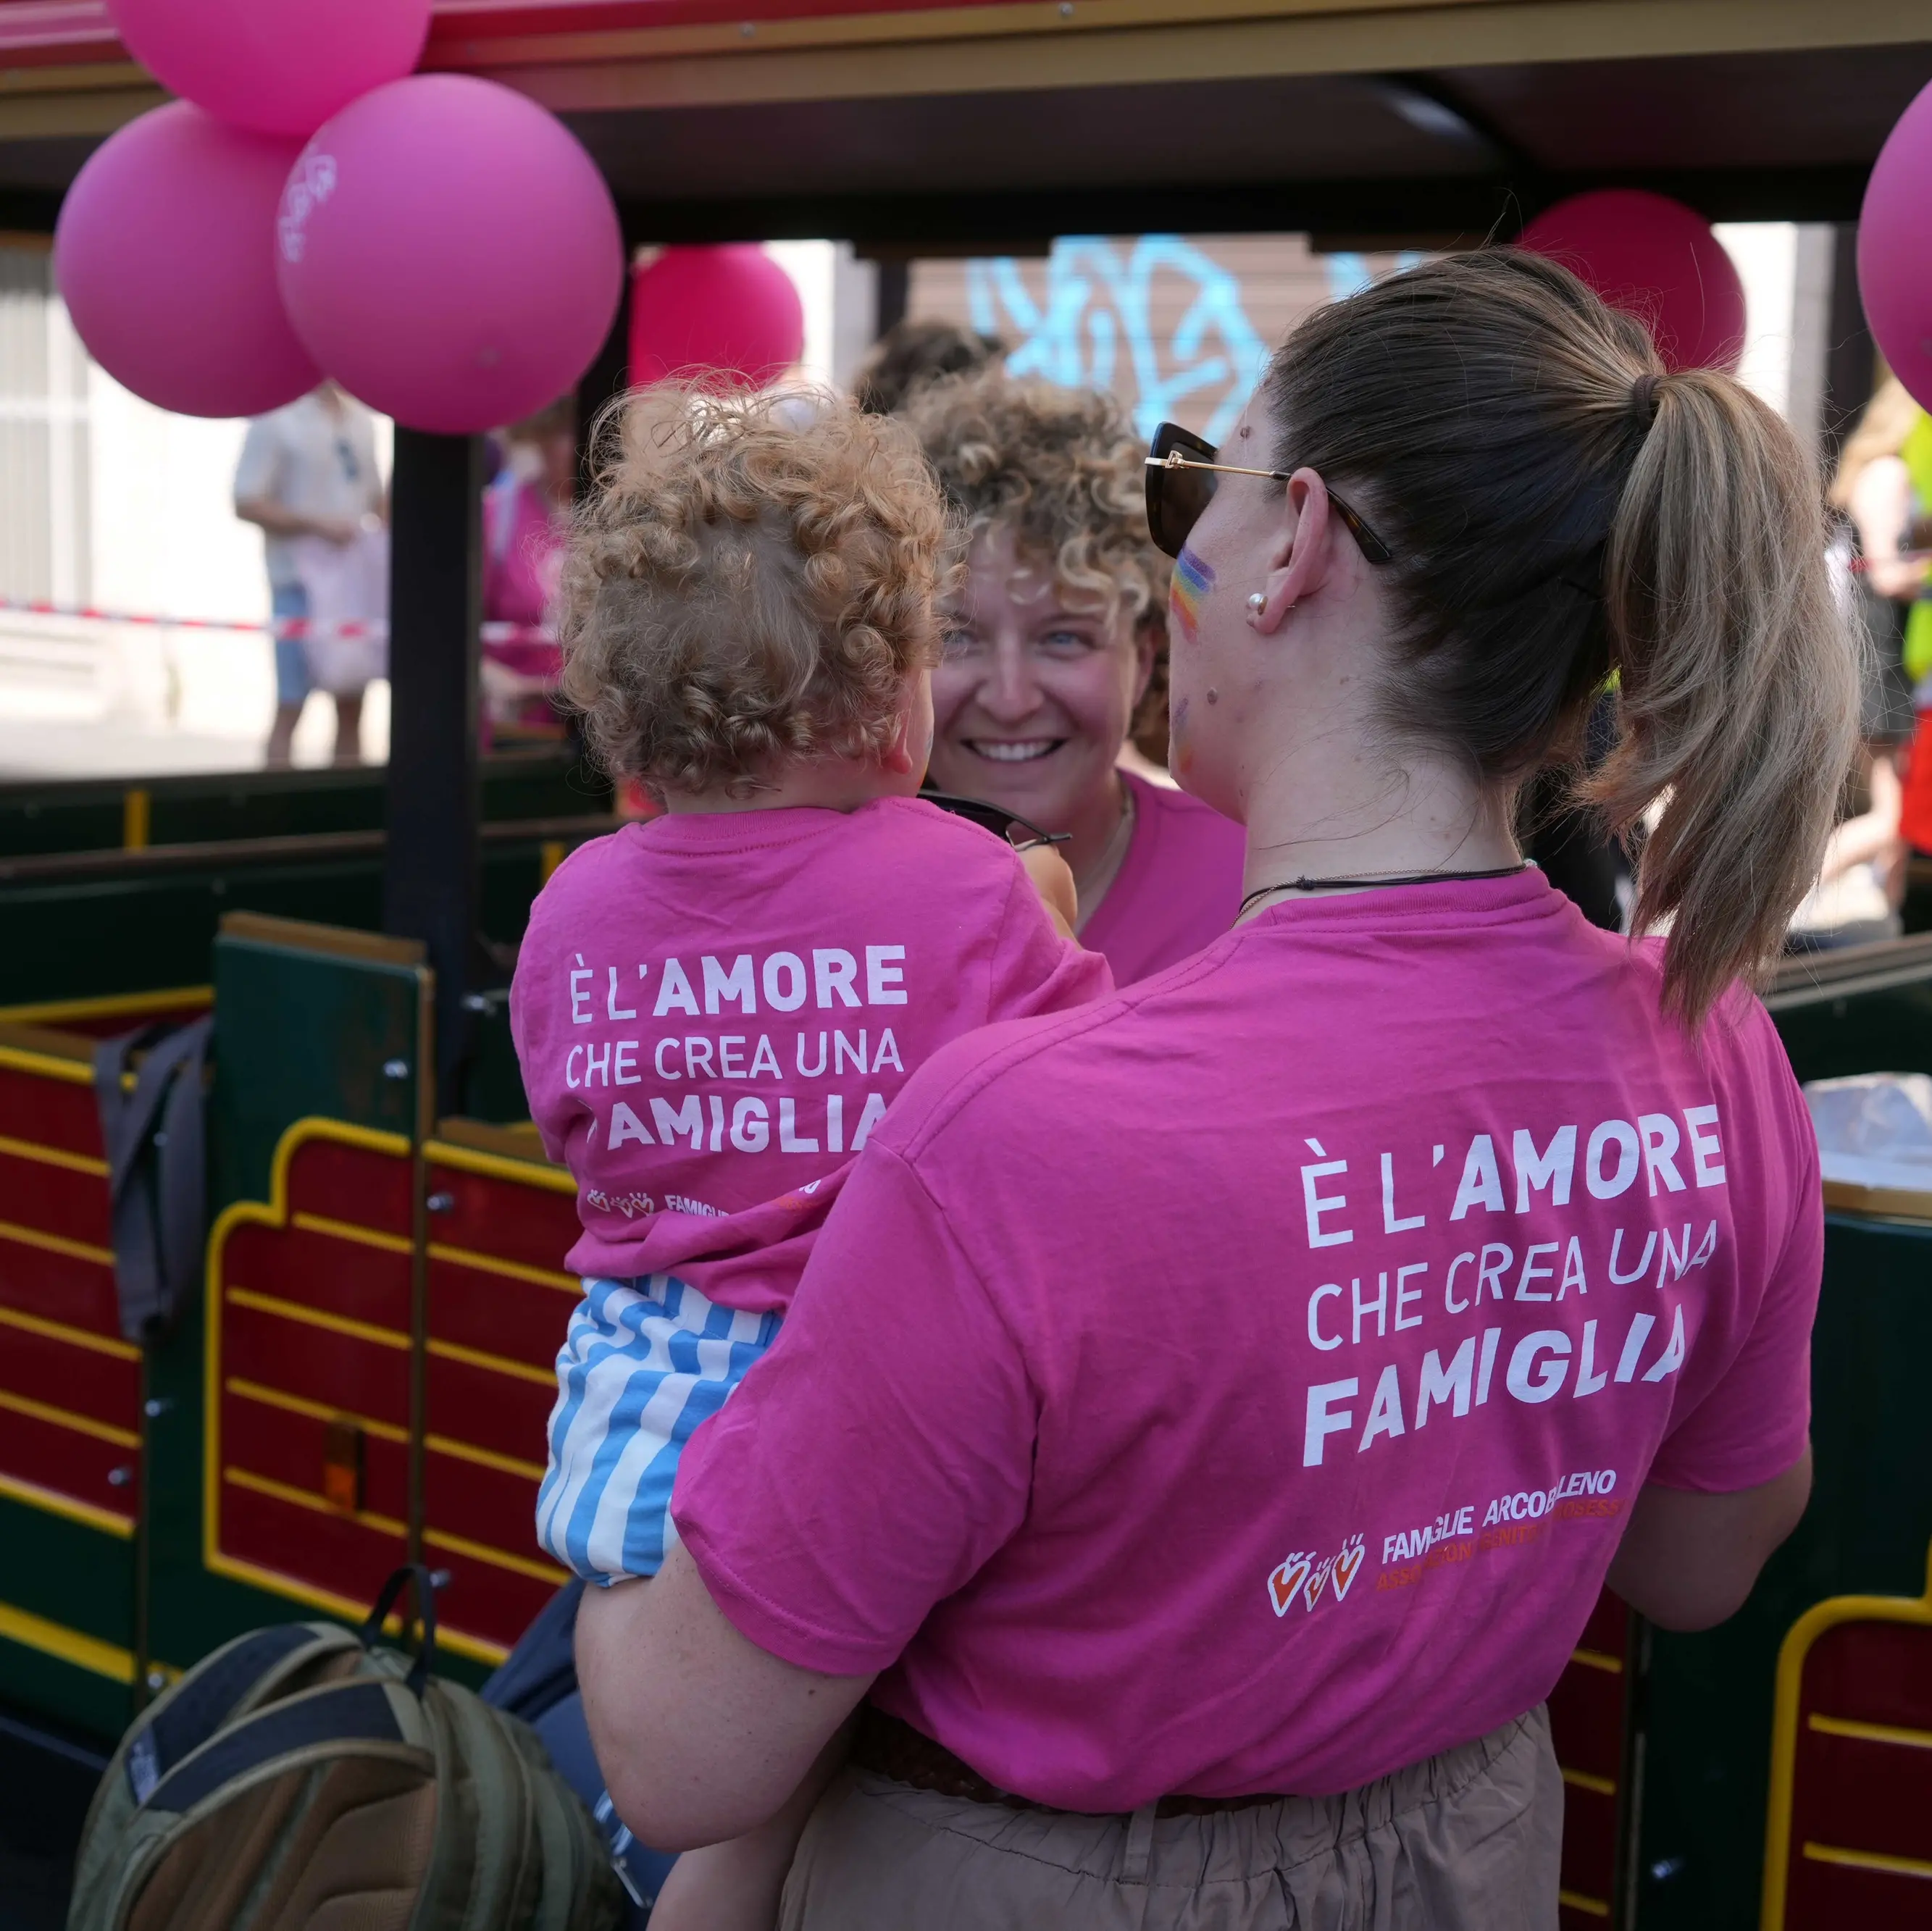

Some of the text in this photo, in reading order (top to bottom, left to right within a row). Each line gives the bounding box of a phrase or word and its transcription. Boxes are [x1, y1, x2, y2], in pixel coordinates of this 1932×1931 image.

[570, 944, 908, 1024] È L'AMORE
[566, 1027, 904, 1088] CHE CREA UNA
[585, 1092, 887, 1153] AMIGLIA
[1300, 1104, 1727, 1249] È L'AMORE
[1308, 1219, 1718, 1352] CHE CREA UNA
[1303, 1303, 1686, 1467] FAMIGLIA
